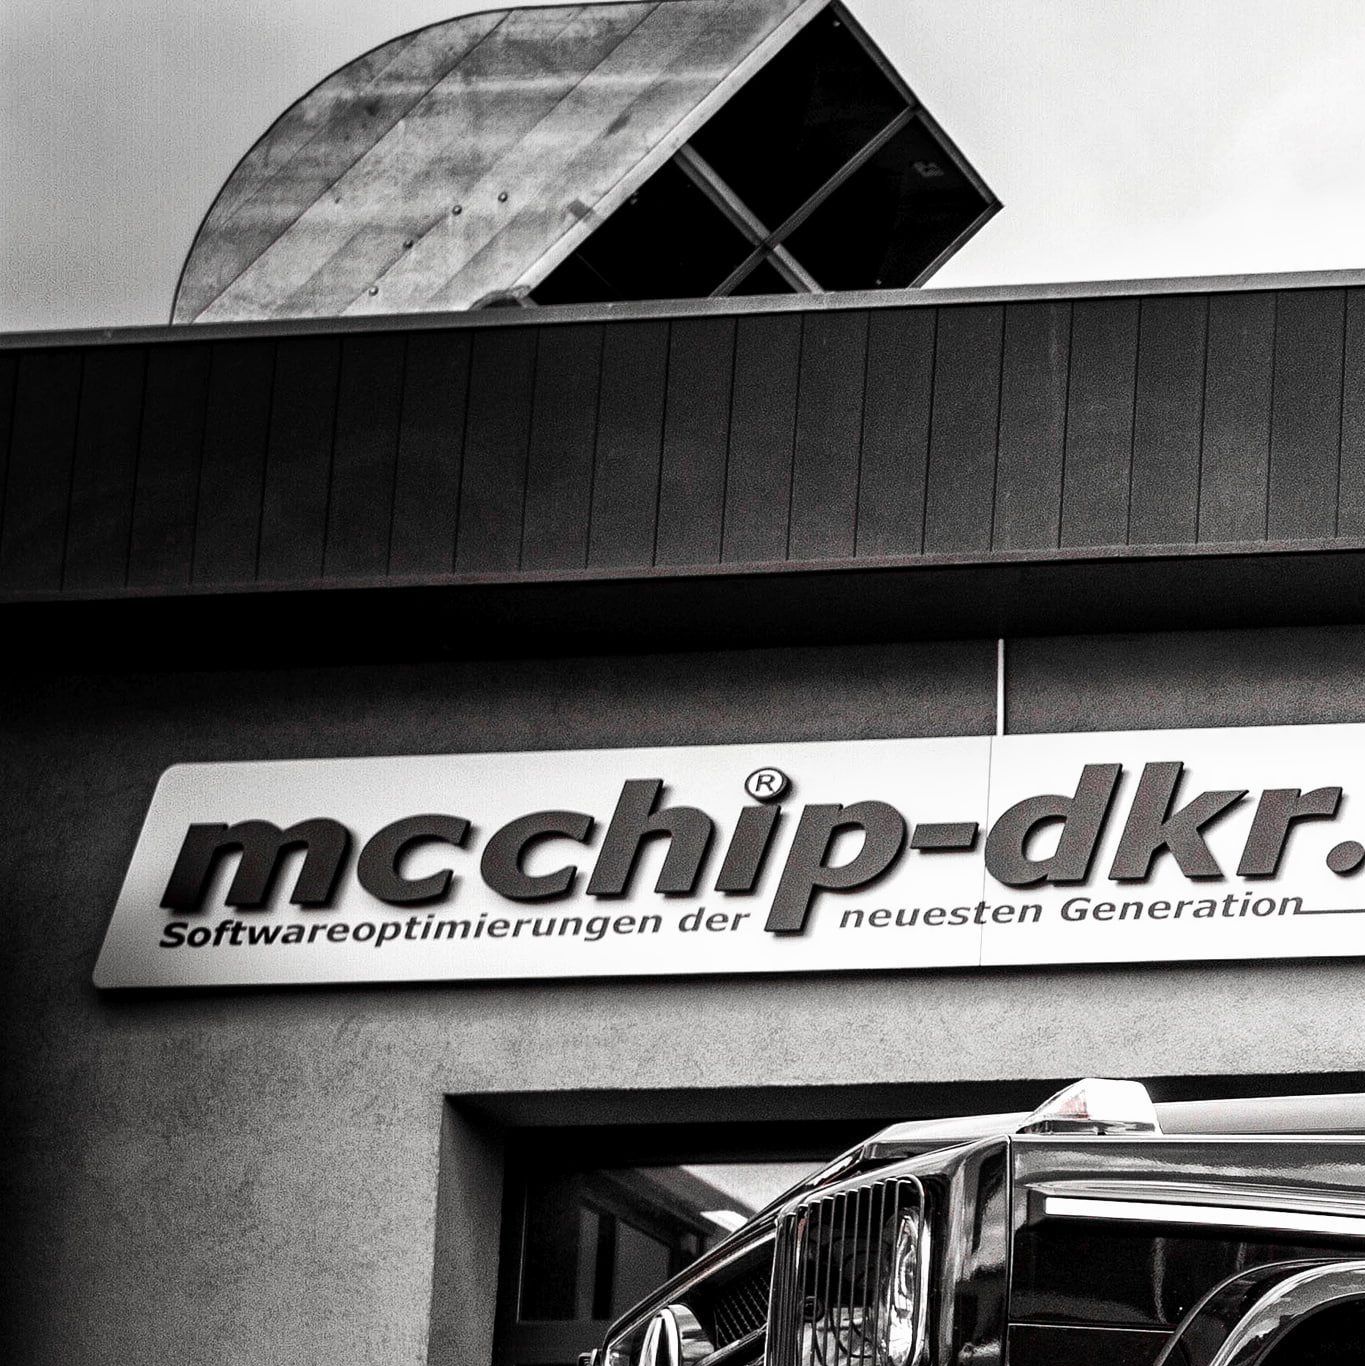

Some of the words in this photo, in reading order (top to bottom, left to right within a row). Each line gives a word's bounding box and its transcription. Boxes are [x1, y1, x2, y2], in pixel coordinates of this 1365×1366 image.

[159, 911, 662, 949] Softwareoptimierungen
[678, 907, 751, 932] der
[839, 900, 1043, 928] neuesten
[1060, 892, 1304, 922] Generation
